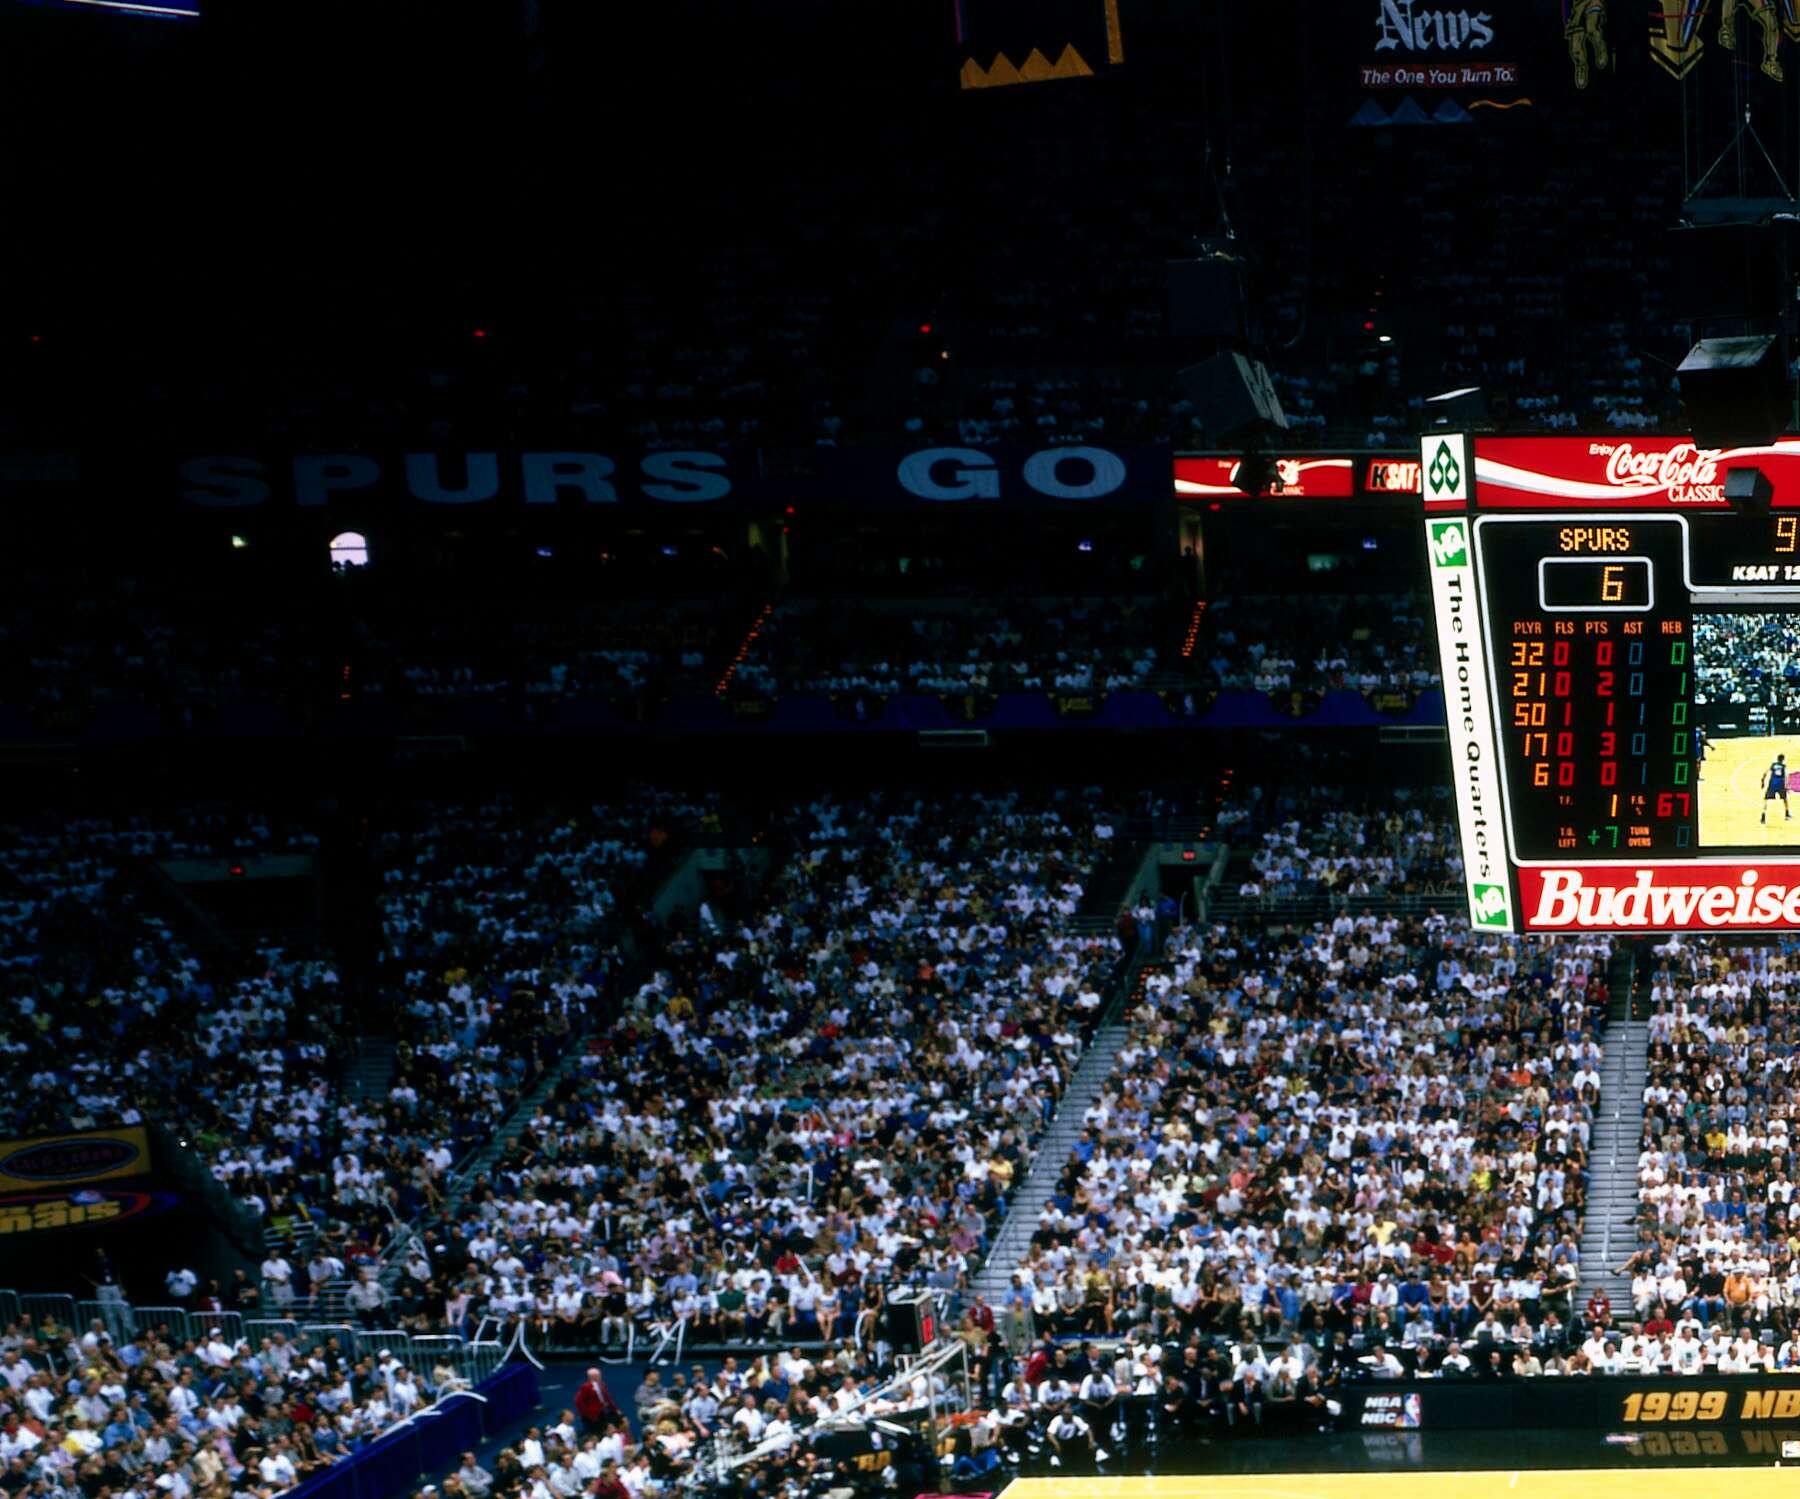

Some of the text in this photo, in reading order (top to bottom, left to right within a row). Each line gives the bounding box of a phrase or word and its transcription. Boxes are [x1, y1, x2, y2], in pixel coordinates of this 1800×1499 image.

[1375, 0, 1495, 50] News
[1362, 70, 1390, 84] The
[1395, 69, 1424, 84] One
[1428, 69, 1457, 83] You
[1461, 69, 1491, 82] Turn
[1589, 444, 1615, 456] Enjoy
[178, 445, 1128, 506] SPURS GO
[1606, 443, 1720, 488] Coca-Cola
[1668, 486, 1725, 502] CLASSIC
[1560, 528, 1630, 552] SPURS
[1602, 566, 1624, 602] 6
[1732, 565, 1779, 581] KSAT
[1514, 621, 1682, 635] PLYR FLS PTS AST REB
[1511, 641, 1686, 666] 32 0 0 0 0
[1513, 672, 1687, 697] 21 0 2 0 1
[1448, 573, 1491, 878] The Home Quarters
[1514, 702, 1687, 726] 50 1 1 0
[1524, 732, 1687, 757] 17 0 3 0 0
[1534, 762, 1689, 786] 6 0 0 0
[1611, 794, 1618, 817] 1
[1657, 793, 1690, 817] 67
[1558, 838, 1576, 848] LEFT
[1628, 838, 1651, 847] OVERS
[1630, 827, 1649, 836] TURN
[1365, 1396, 1401, 1409] NBA
[1622, 1391, 1729, 1422] 1999
[1361, 1412, 1398, 1425] NBC
